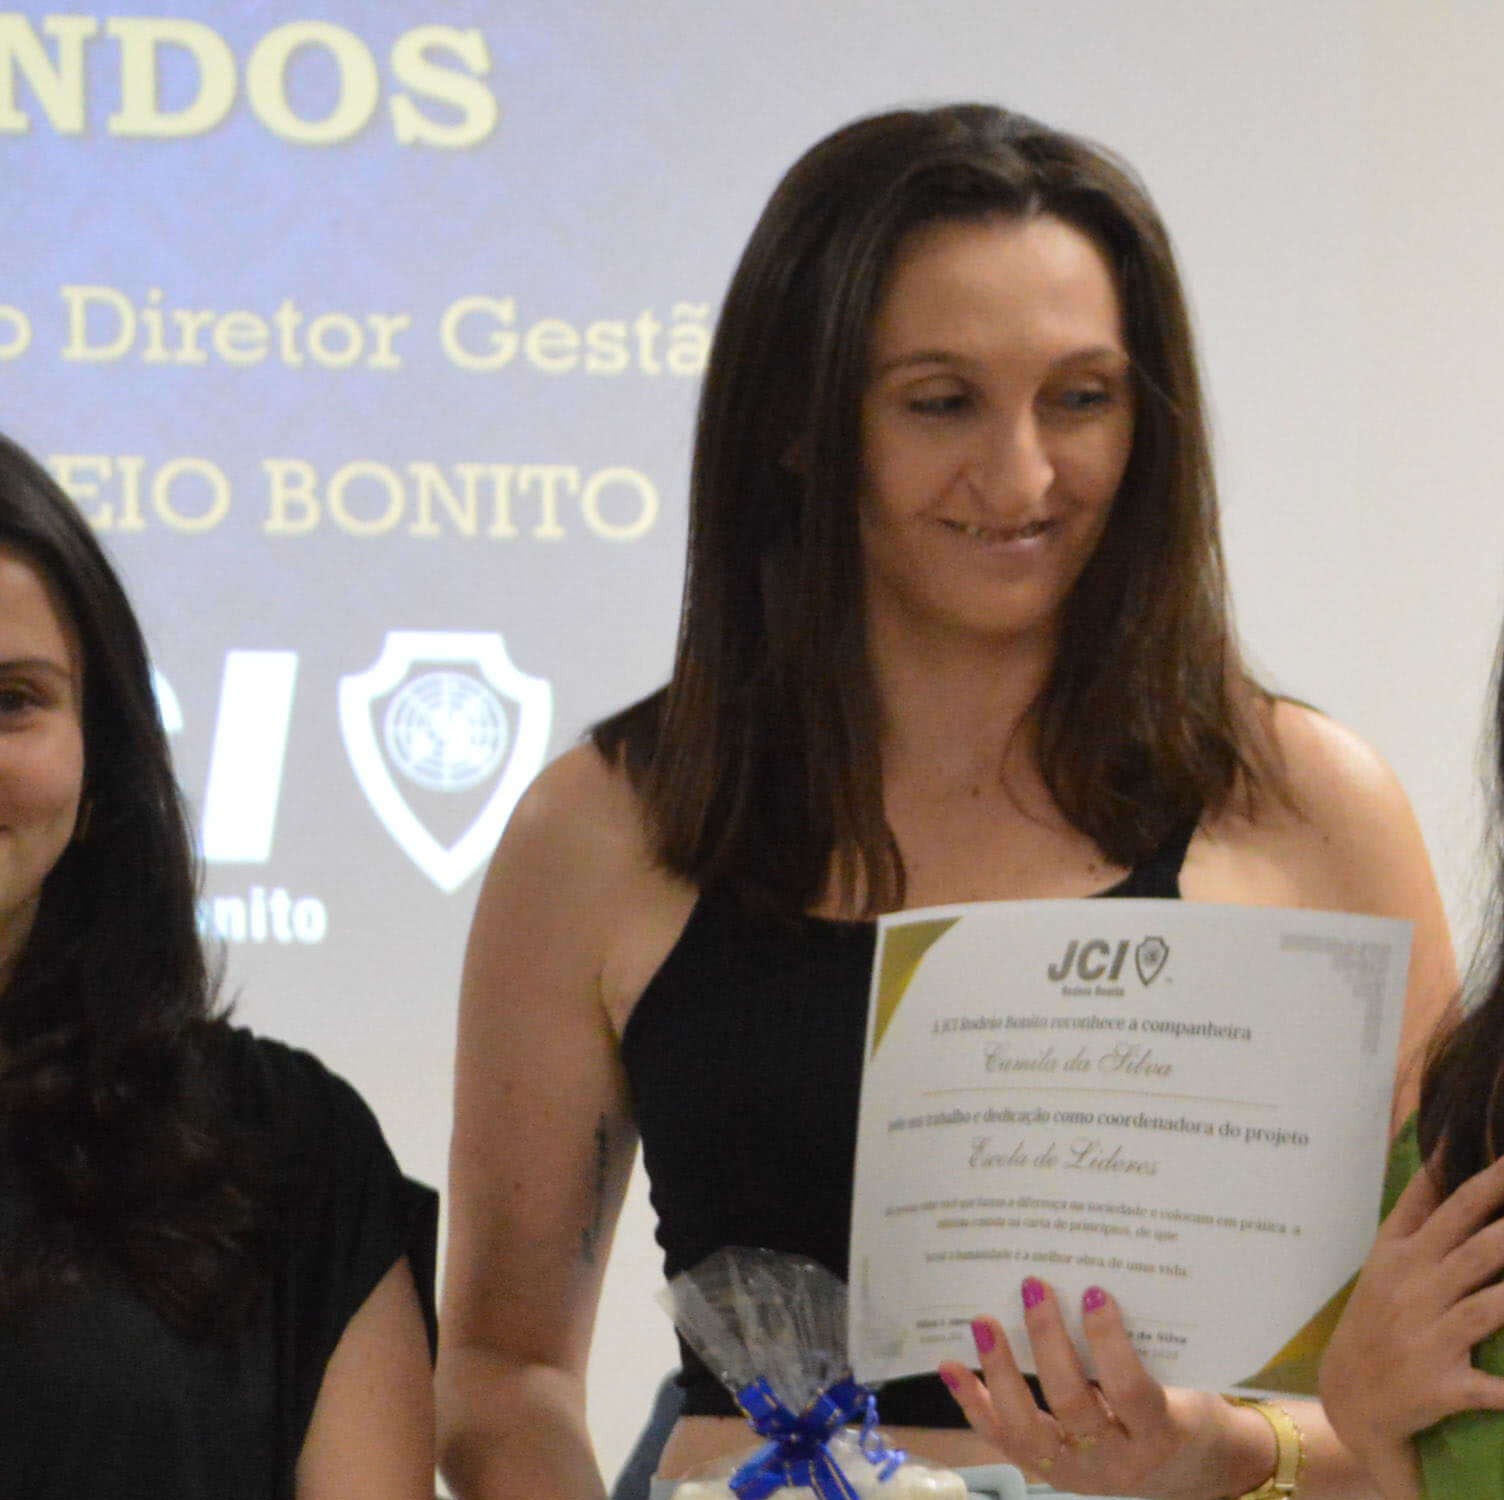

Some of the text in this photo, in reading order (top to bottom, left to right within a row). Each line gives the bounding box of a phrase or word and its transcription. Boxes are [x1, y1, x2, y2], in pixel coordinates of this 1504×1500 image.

[0, 13, 499, 148] NDOS
[59, 284, 412, 370] Diretor
[439, 294, 713, 377] Gestã
[49, 453, 660, 543] EIO BONITO
[196, 886, 328, 943] nito
[1048, 938, 1131, 982] JCI
[1050, 1013, 1126, 1032] reconhece
[1141, 1018, 1252, 1042] companheira
[1098, 1043, 1175, 1077] Silva
[1053, 1110, 1094, 1125] como
[1097, 1112, 1215, 1136] coordenadora
[1218, 1119, 1242, 1138] do
[1244, 1126, 1311, 1149] projeto
